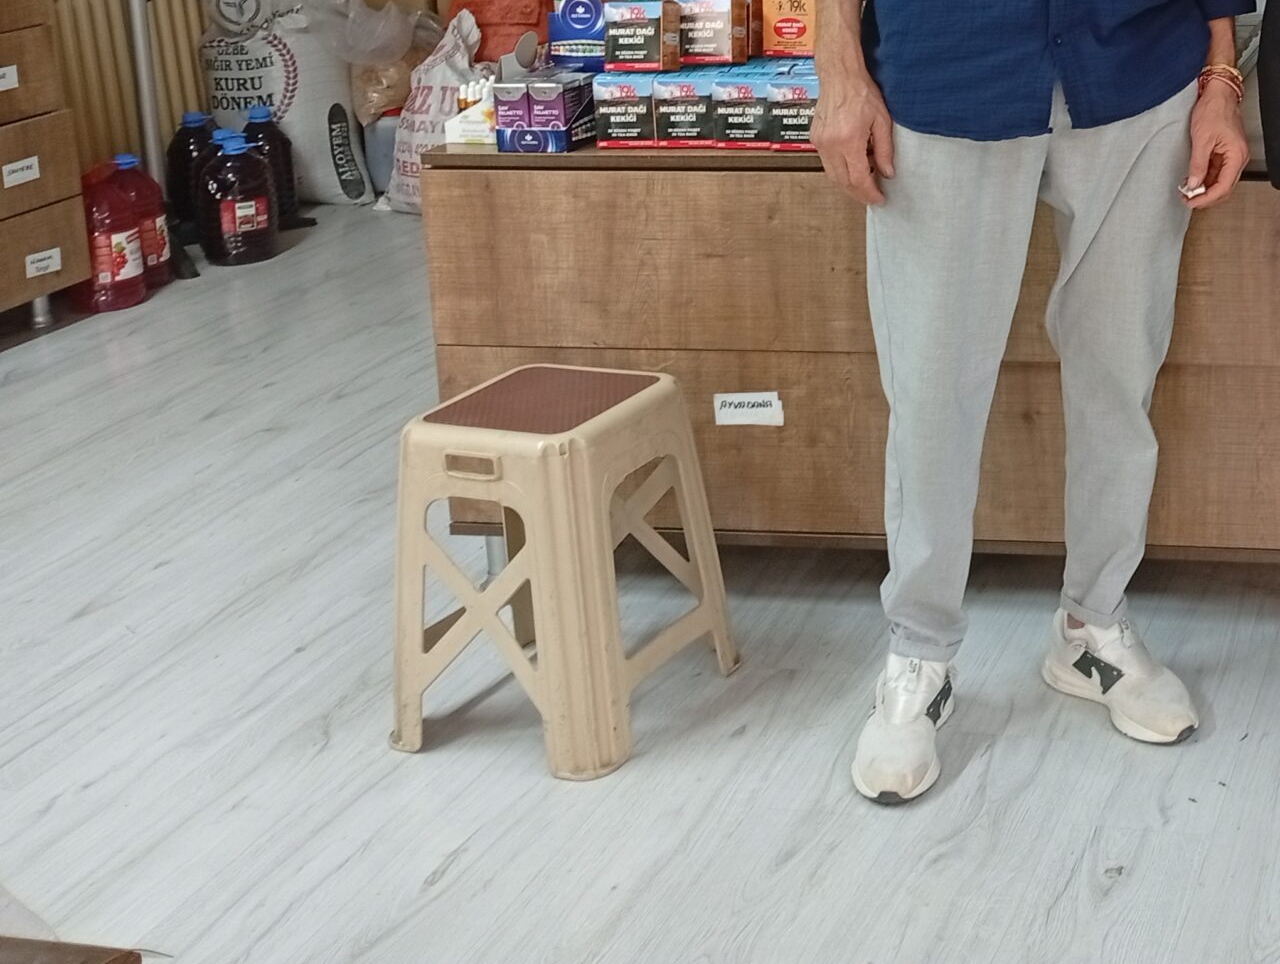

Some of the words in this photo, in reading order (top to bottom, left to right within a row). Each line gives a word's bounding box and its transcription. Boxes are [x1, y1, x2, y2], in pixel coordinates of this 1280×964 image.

[788, 0, 806, 12] 19k
[680, 21, 704, 29] MURAT
[609, 27, 635, 36] MURAT
[205, 56, 232, 71] ĞIR
[235, 52, 274, 71] YEMİ
[214, 76, 262, 91] KURU
[212, 93, 275, 111] DÖNEM
[600, 106, 625, 114] MURAT
[660, 105, 685, 113] MURAT
[717, 107, 743, 115] MURAT
[772, 108, 798, 116] MURAT
[800, 107, 815, 116] DAĞ
